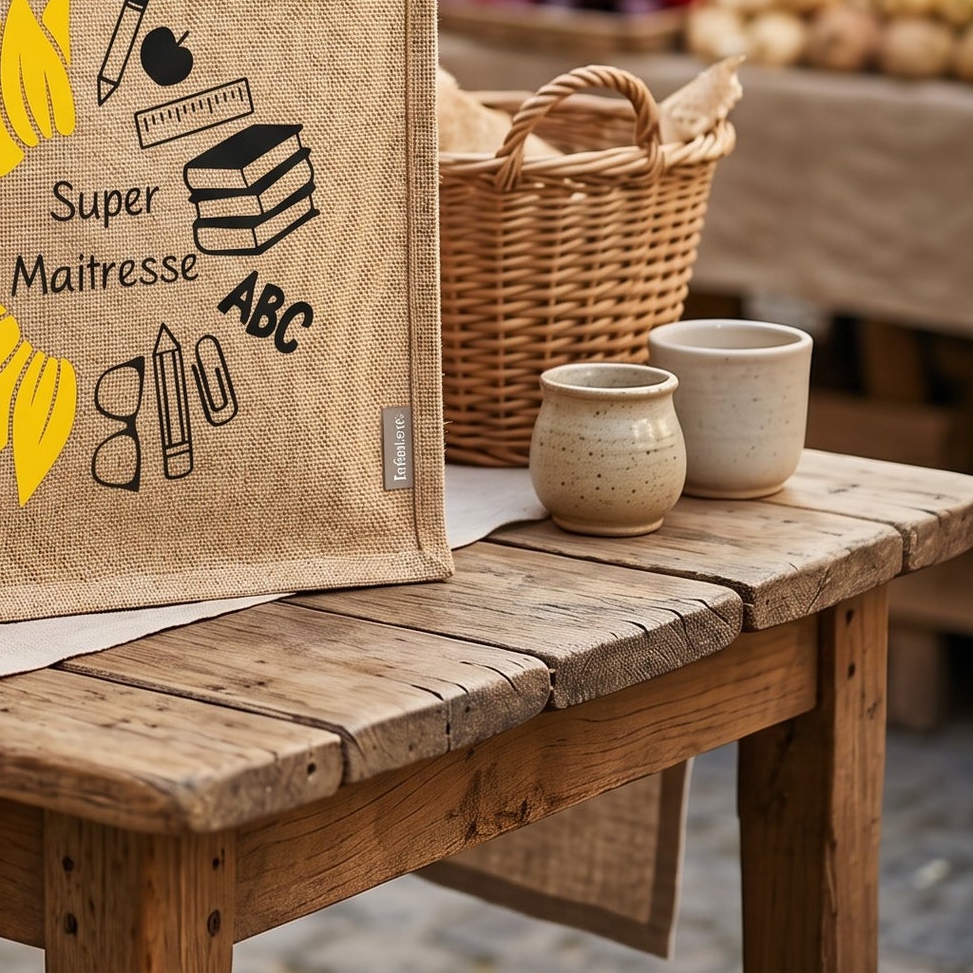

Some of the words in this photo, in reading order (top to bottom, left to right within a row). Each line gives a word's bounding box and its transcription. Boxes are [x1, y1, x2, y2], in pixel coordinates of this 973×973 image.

[50, 180, 159, 228] Super
[11, 253, 199, 297] Maitresse
[216, 270, 314, 354] ABC
